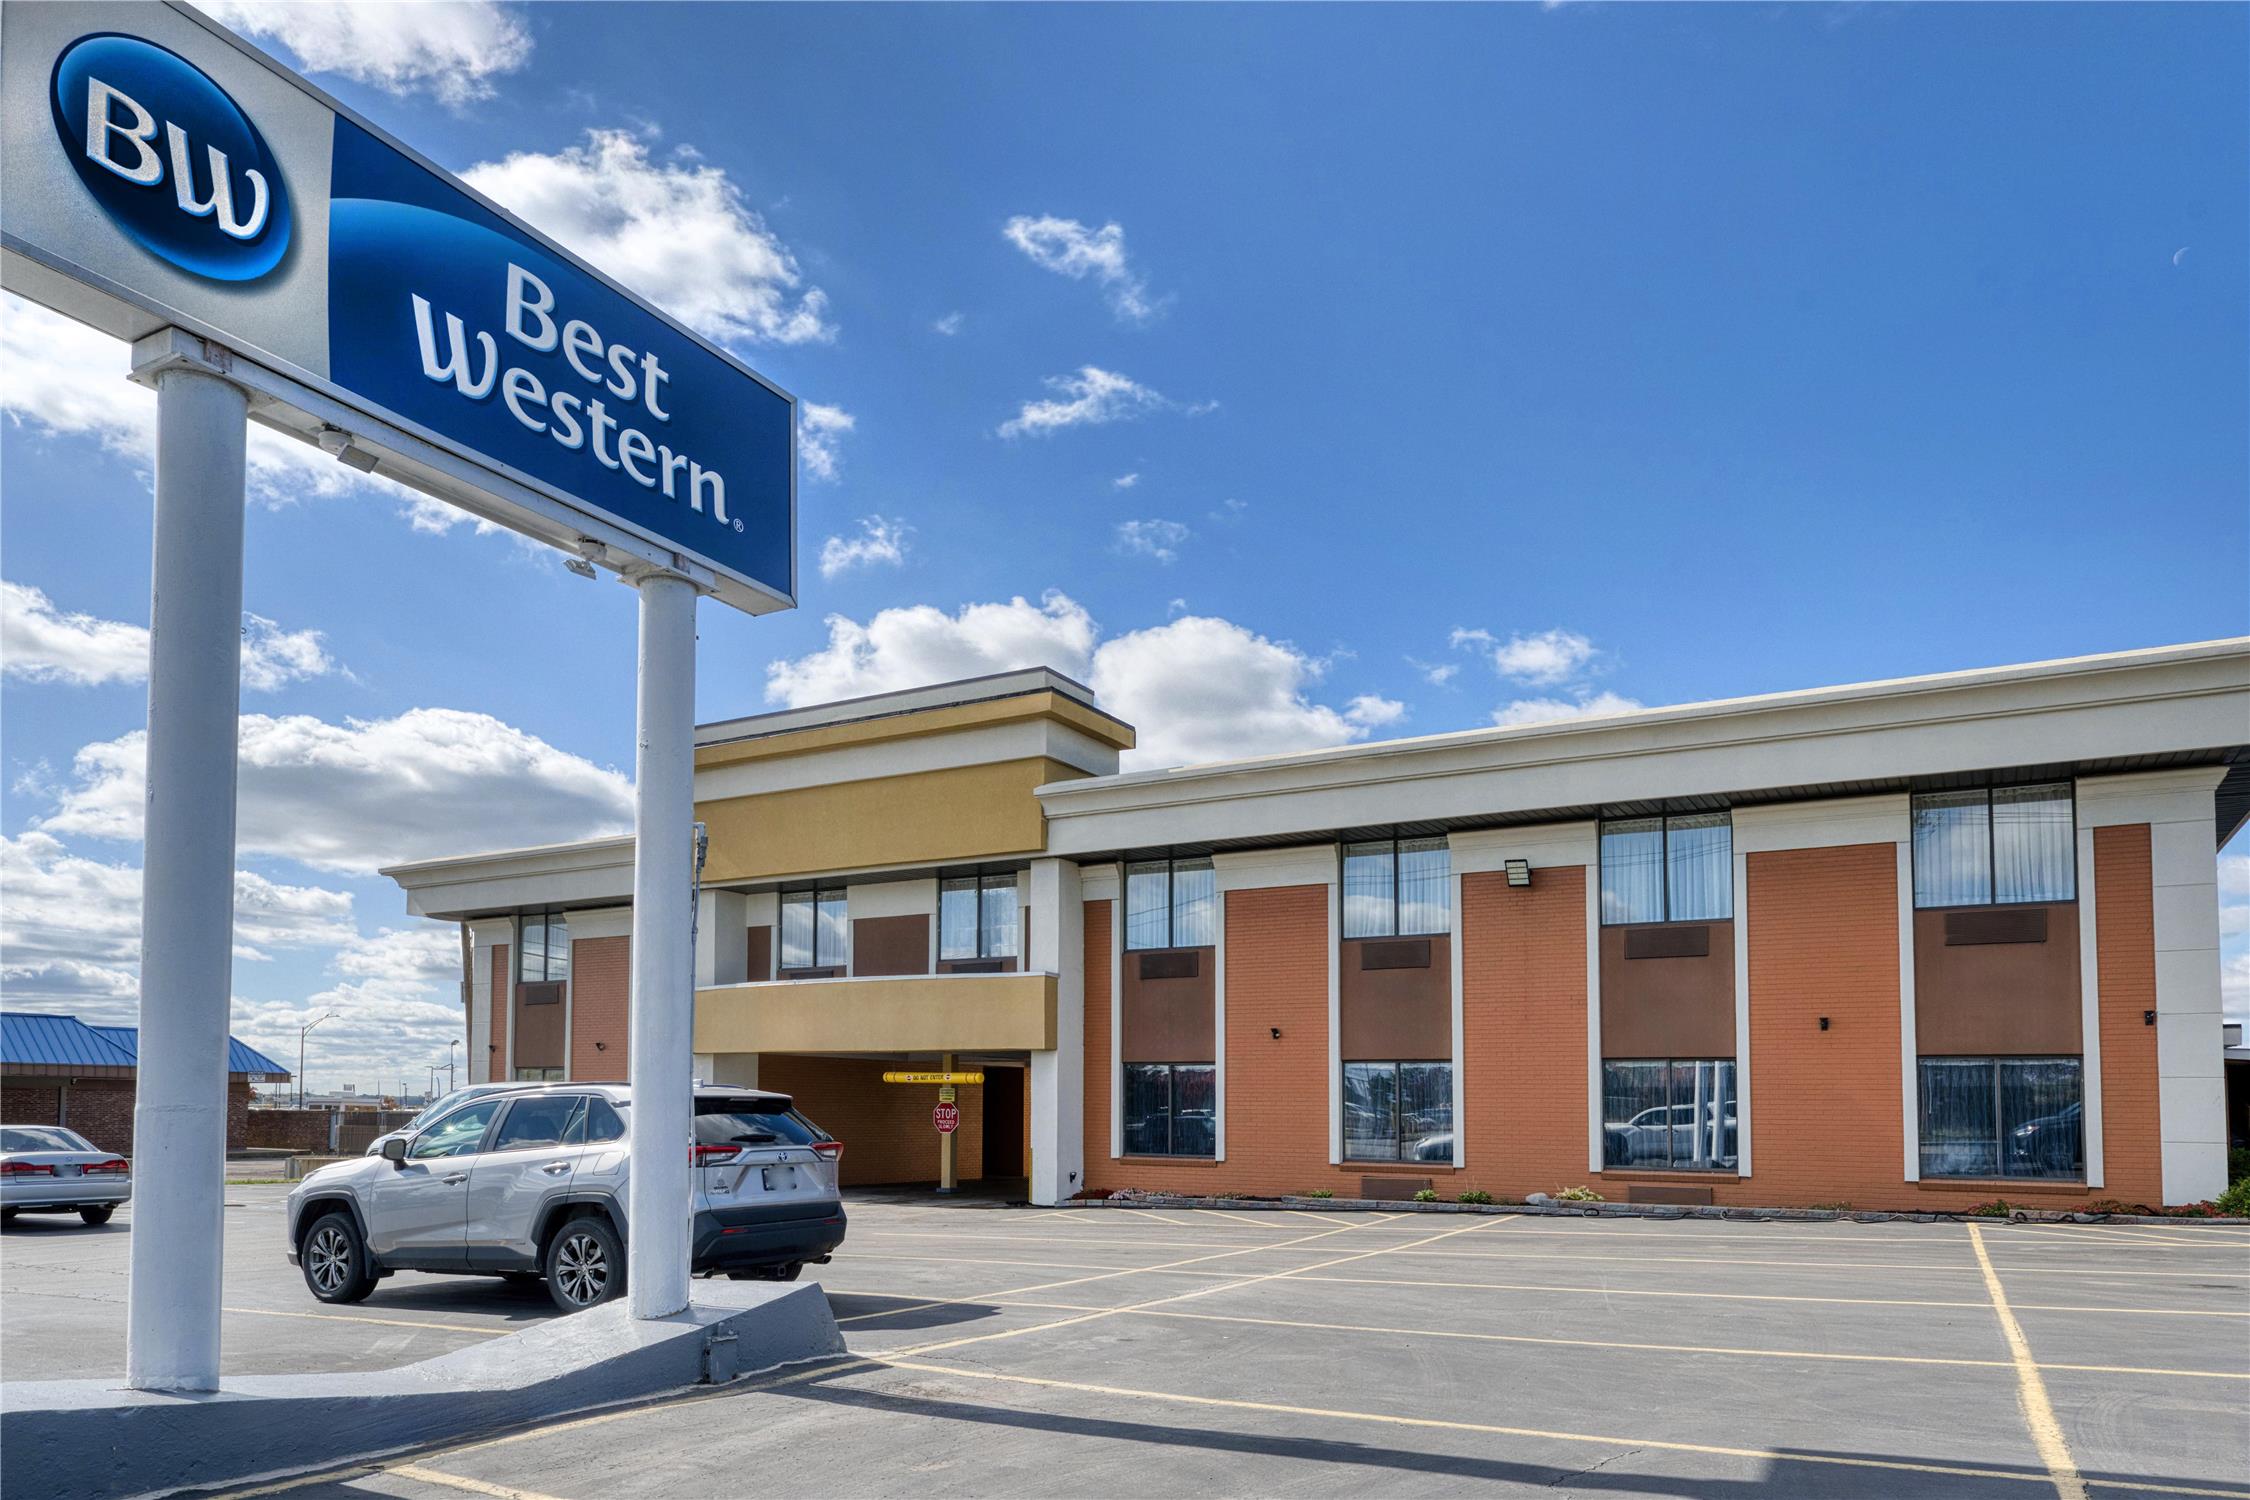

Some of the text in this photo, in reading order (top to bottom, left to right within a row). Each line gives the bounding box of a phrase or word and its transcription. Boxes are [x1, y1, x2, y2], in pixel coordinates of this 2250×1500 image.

[86, 76, 270, 240] BW
[505, 262, 670, 421] Best
[935, 1108, 957, 1119] STOP
